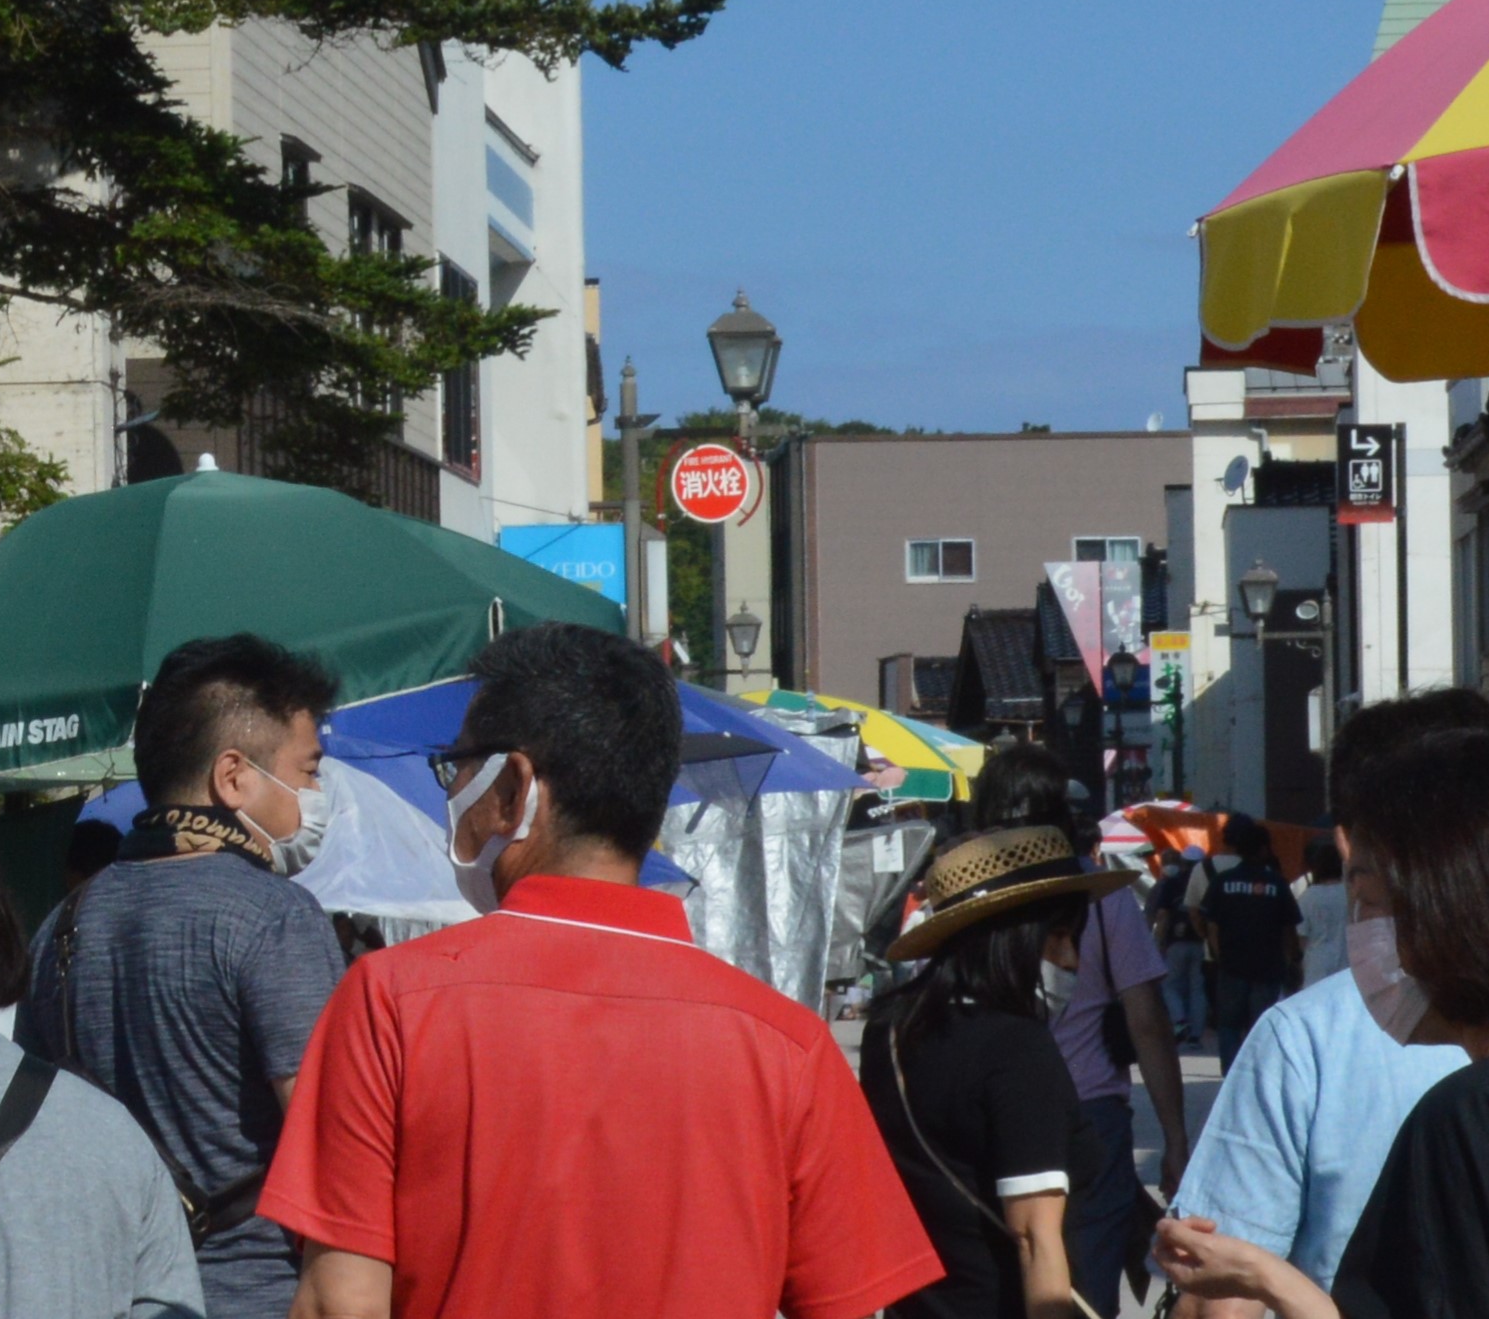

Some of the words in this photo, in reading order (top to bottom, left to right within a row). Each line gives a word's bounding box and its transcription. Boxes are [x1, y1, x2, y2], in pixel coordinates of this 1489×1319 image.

[680, 467, 743, 500] 消火栓
[27, 713, 80, 745] STAG
